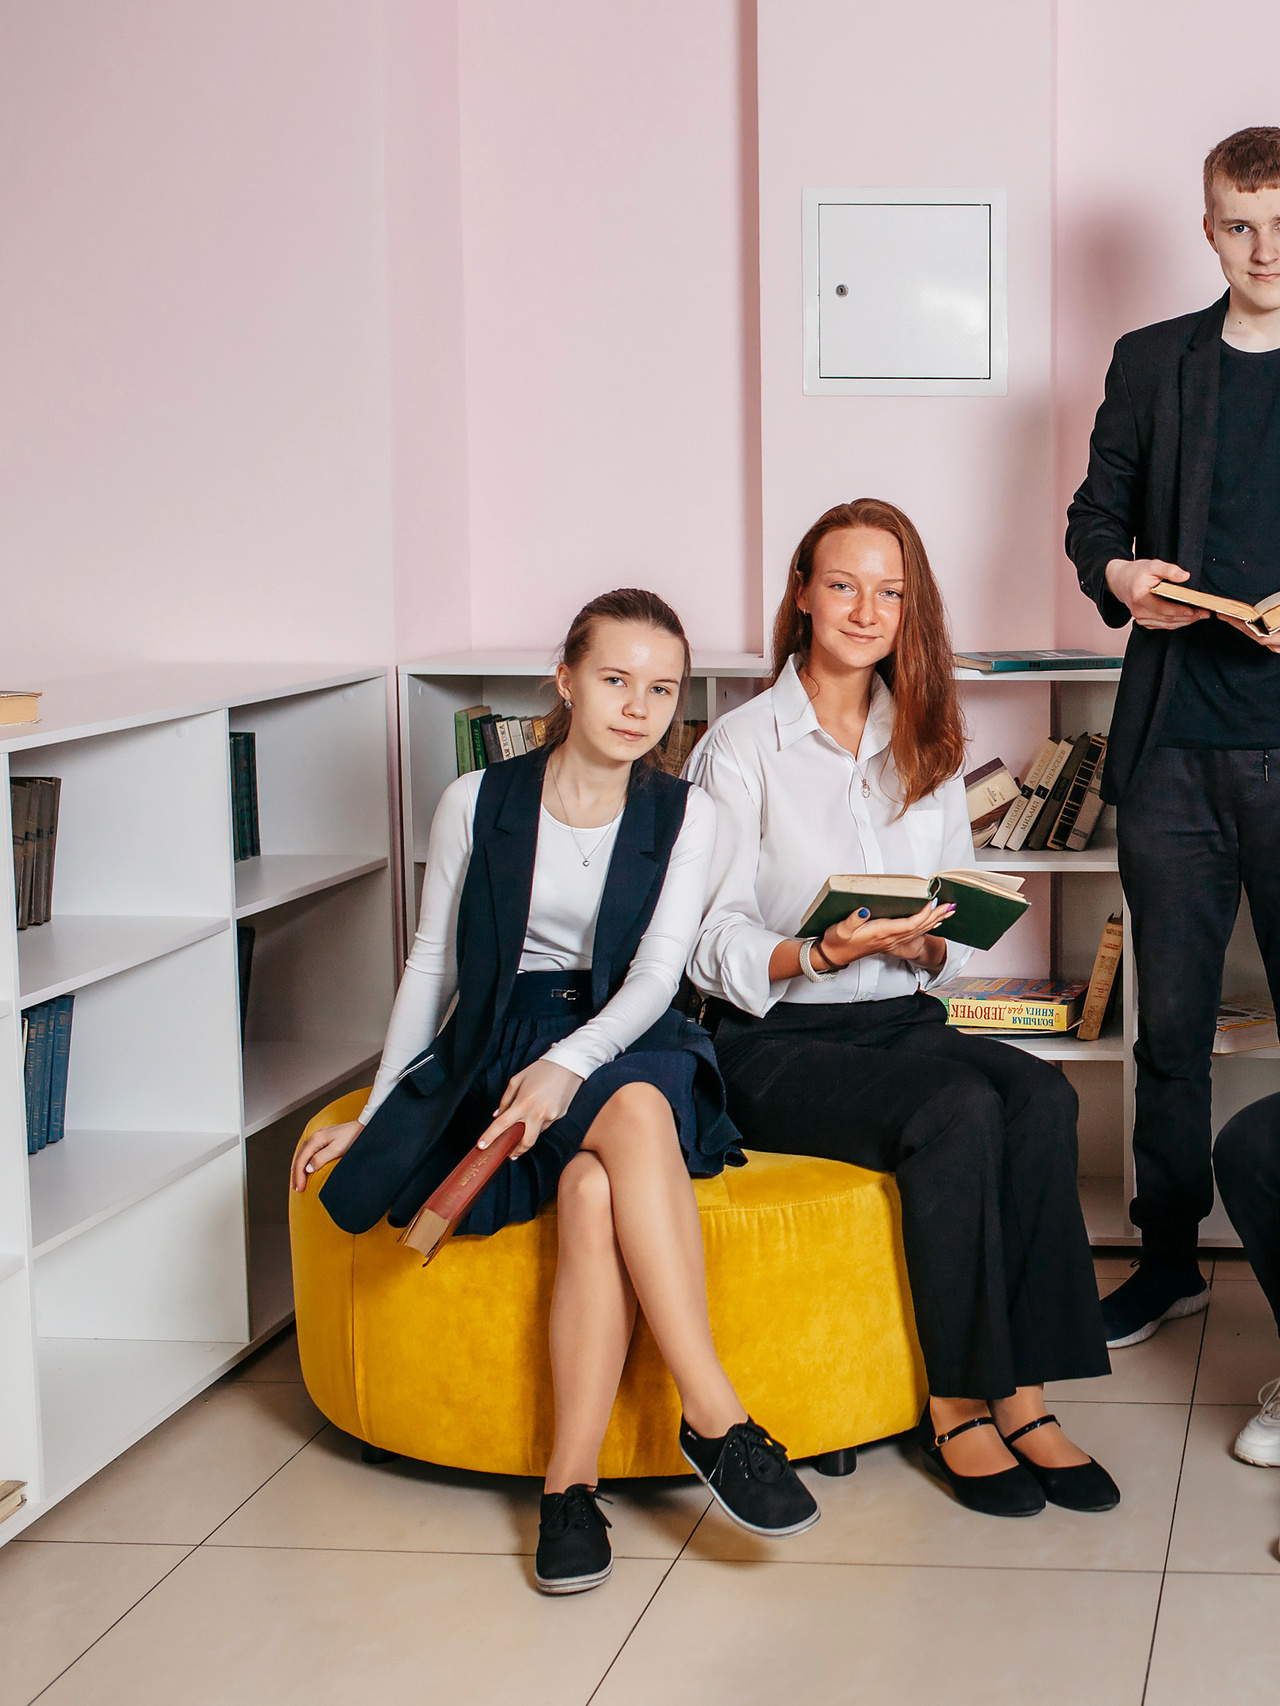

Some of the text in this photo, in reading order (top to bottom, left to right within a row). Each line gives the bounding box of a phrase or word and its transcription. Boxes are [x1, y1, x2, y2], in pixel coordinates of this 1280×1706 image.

[498, 723, 509, 747] КОЖА
[1005, 800, 1025, 830] МИХАИЛ
[1028, 749, 1051, 785] АЛЕКСЕЕВ
[1020, 800, 1040, 831] МИХАИЛ
[1044, 749, 1066, 786] АЛЕКСЕЕВ
[951, 1003, 1055, 1021] КНИГА для ДЕВОЧЕК
[1012, 1016, 1054, 1027] БОЛЬШАЯ
